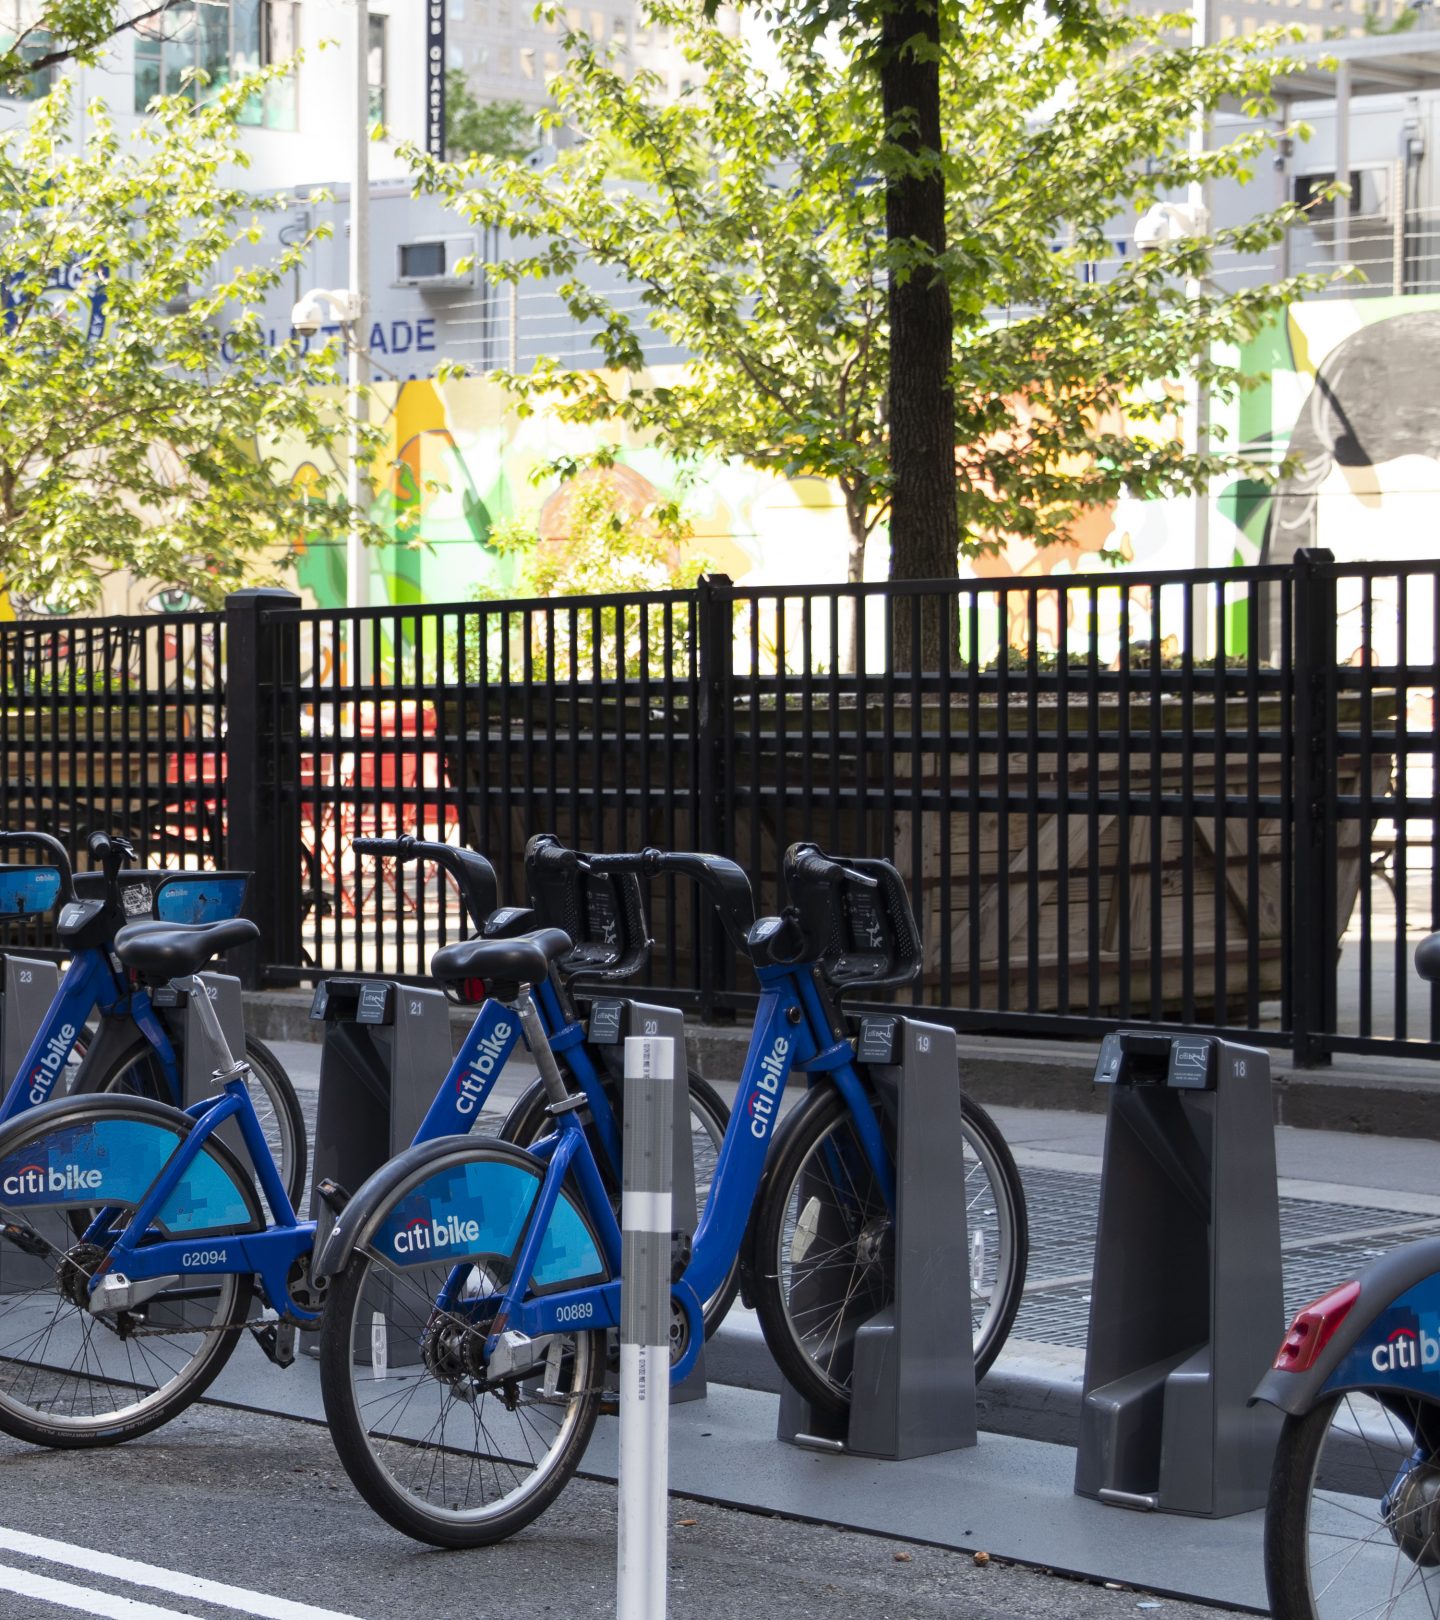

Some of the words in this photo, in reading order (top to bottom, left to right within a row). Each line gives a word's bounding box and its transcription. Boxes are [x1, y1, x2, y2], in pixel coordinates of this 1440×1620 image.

[430, 0, 442, 35] UB
[321, 319, 436, 357] TADE
[20, 971, 32, 983] 23
[206, 987, 217, 1000] 22
[410, 1001, 423, 1015] 21
[645, 1020, 657, 1034] 20
[469, 1022, 512, 1075] bike
[918, 1036, 929, 1052] 19
[29, 1065, 53, 1105] citi
[41, 1023, 76, 1071] bike
[756, 1036, 789, 1095] bike
[1233, 1061, 1247, 1078] 18
[456, 1071, 486, 1114] citi
[748, 1090, 773, 1139] citi
[3, 1165, 44, 1195] citi
[48, 1164, 103, 1192] bike
[394, 1218, 430, 1253] citi
[432, 1216, 480, 1247] bike
[182, 1250, 227, 1267] 02094
[556, 1302, 593, 1322] 00889
[1372, 1328, 1417, 1371] citi
